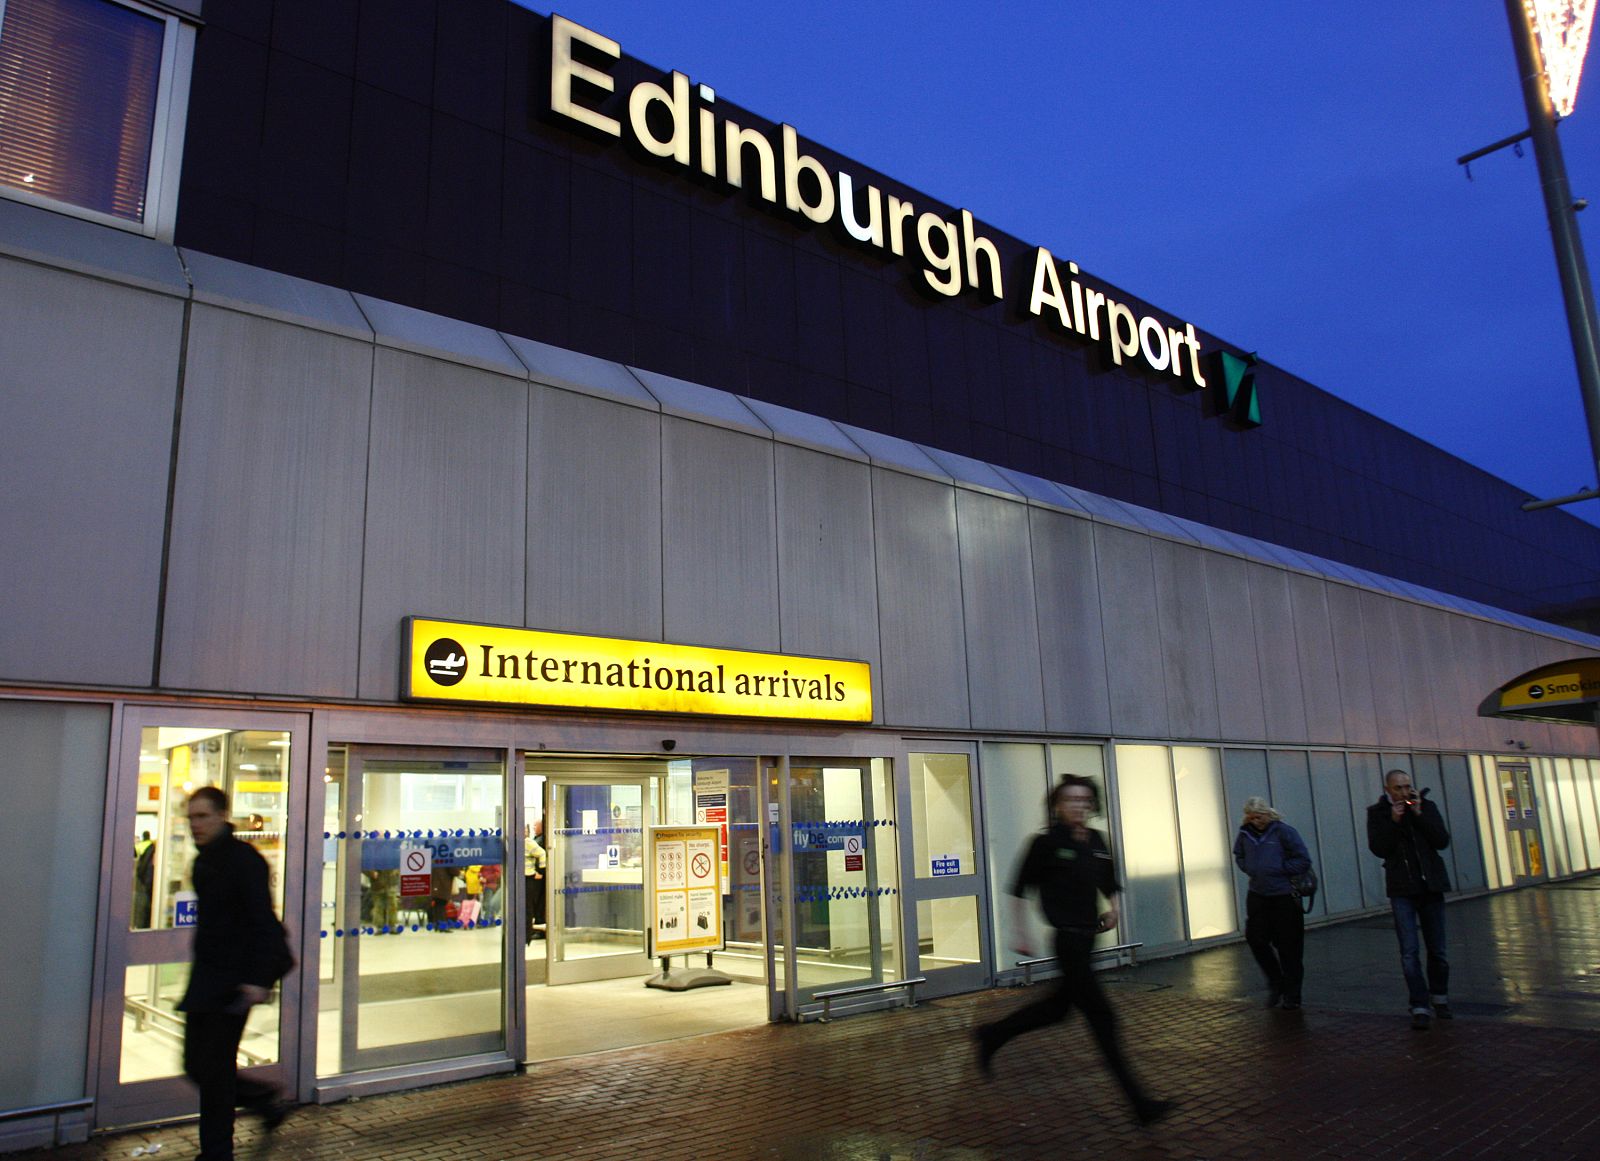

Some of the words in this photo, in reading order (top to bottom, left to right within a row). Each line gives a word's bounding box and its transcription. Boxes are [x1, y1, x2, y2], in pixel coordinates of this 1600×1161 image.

[551, 14, 1003, 299] Edinburgh
[1029, 246, 1206, 388] Airport
[479, 644, 725, 694] International
[735, 669, 846, 702] arrivals
